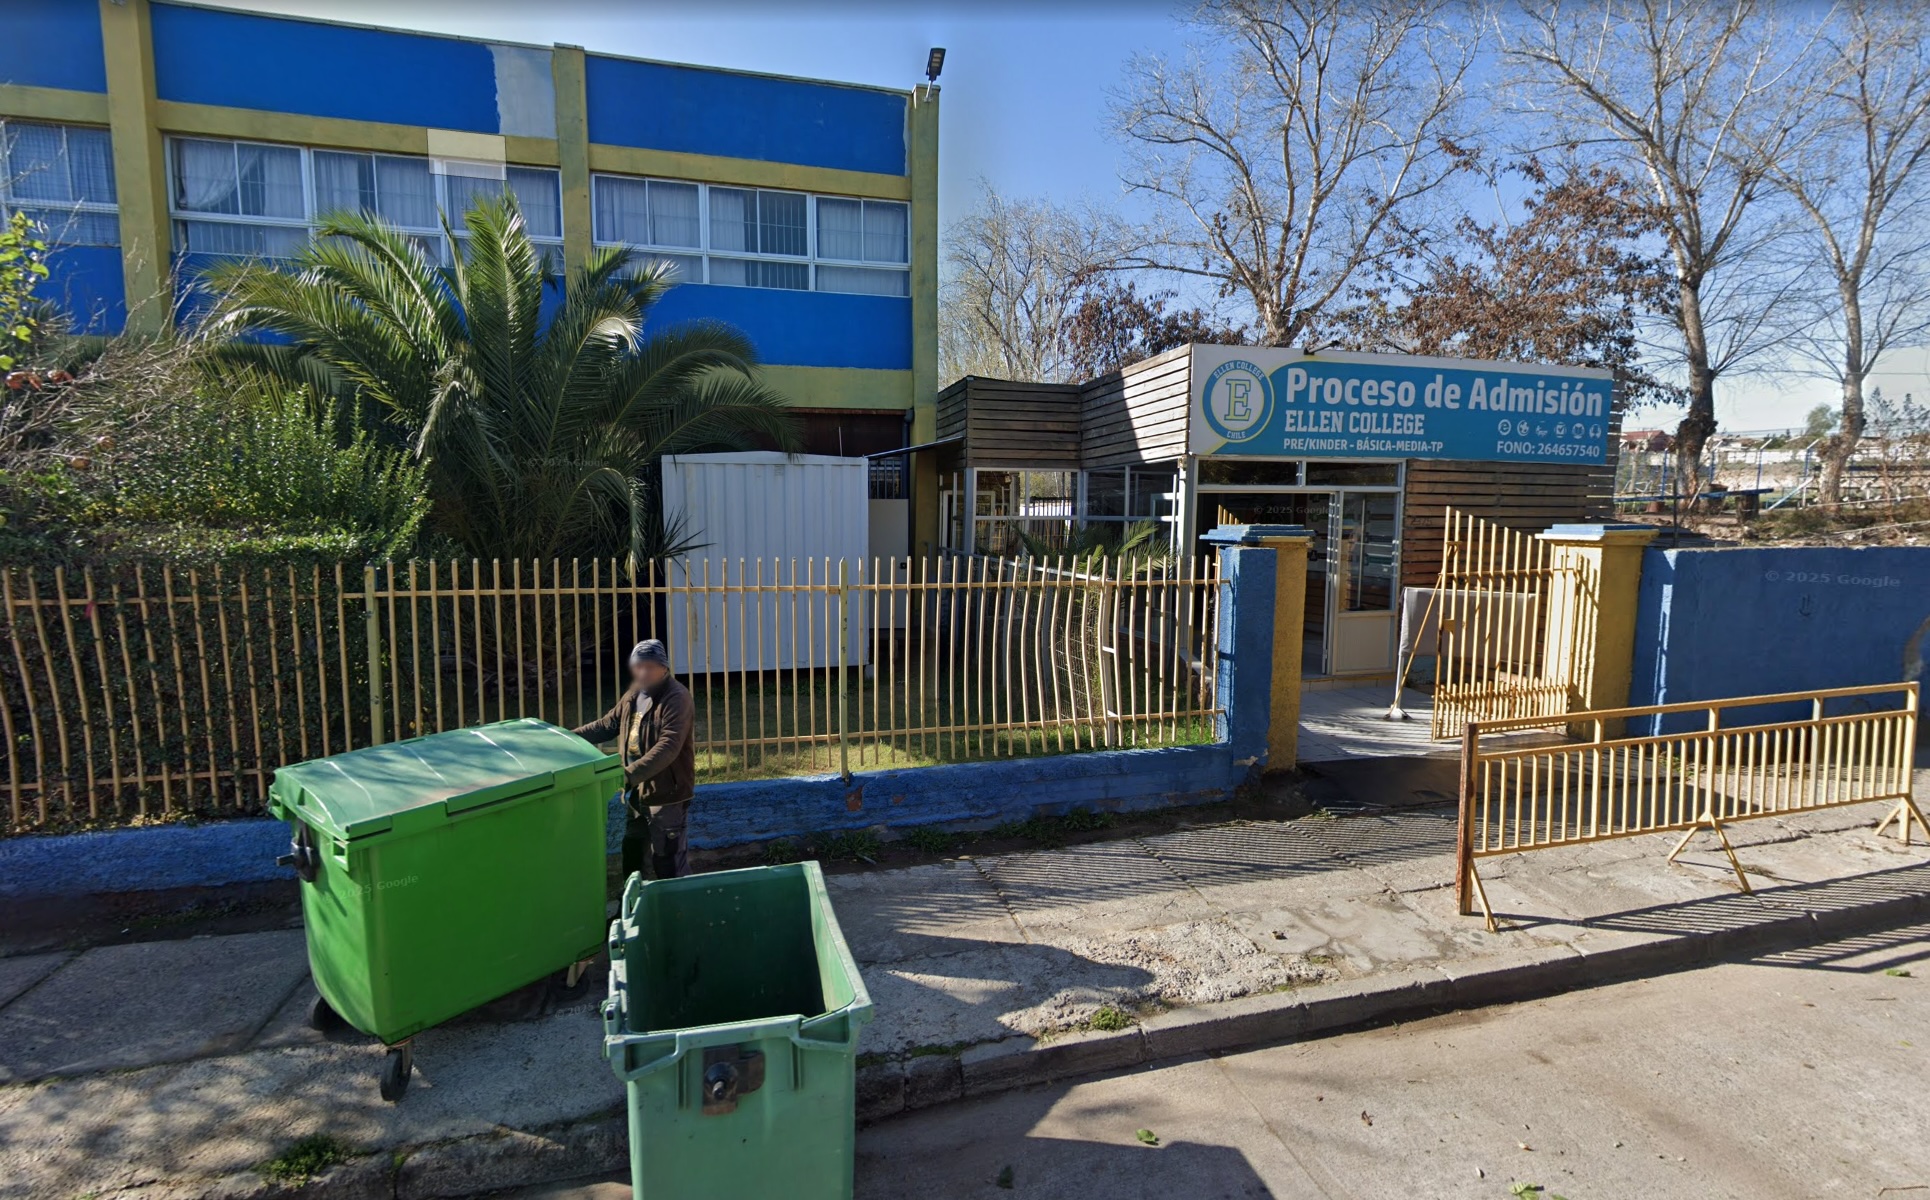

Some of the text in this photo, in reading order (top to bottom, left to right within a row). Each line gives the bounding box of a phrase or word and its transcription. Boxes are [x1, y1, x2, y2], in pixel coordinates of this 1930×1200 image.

[1213, 361, 1265, 380] ELLEN COLLEGE
[1223, 378, 1252, 421] E
[1286, 367, 1602, 417] Proceso de Admisión
[1285, 409, 1425, 435] ELLEN COLLEGE
[1227, 430, 1246, 440] CHILE
[1283, 437, 1348, 451] PRE/KINDER
[1356, 437, 1443, 453] BÁSICA-MEDIA-TP
[1496, 441, 1600, 457] FONO: 264657540
